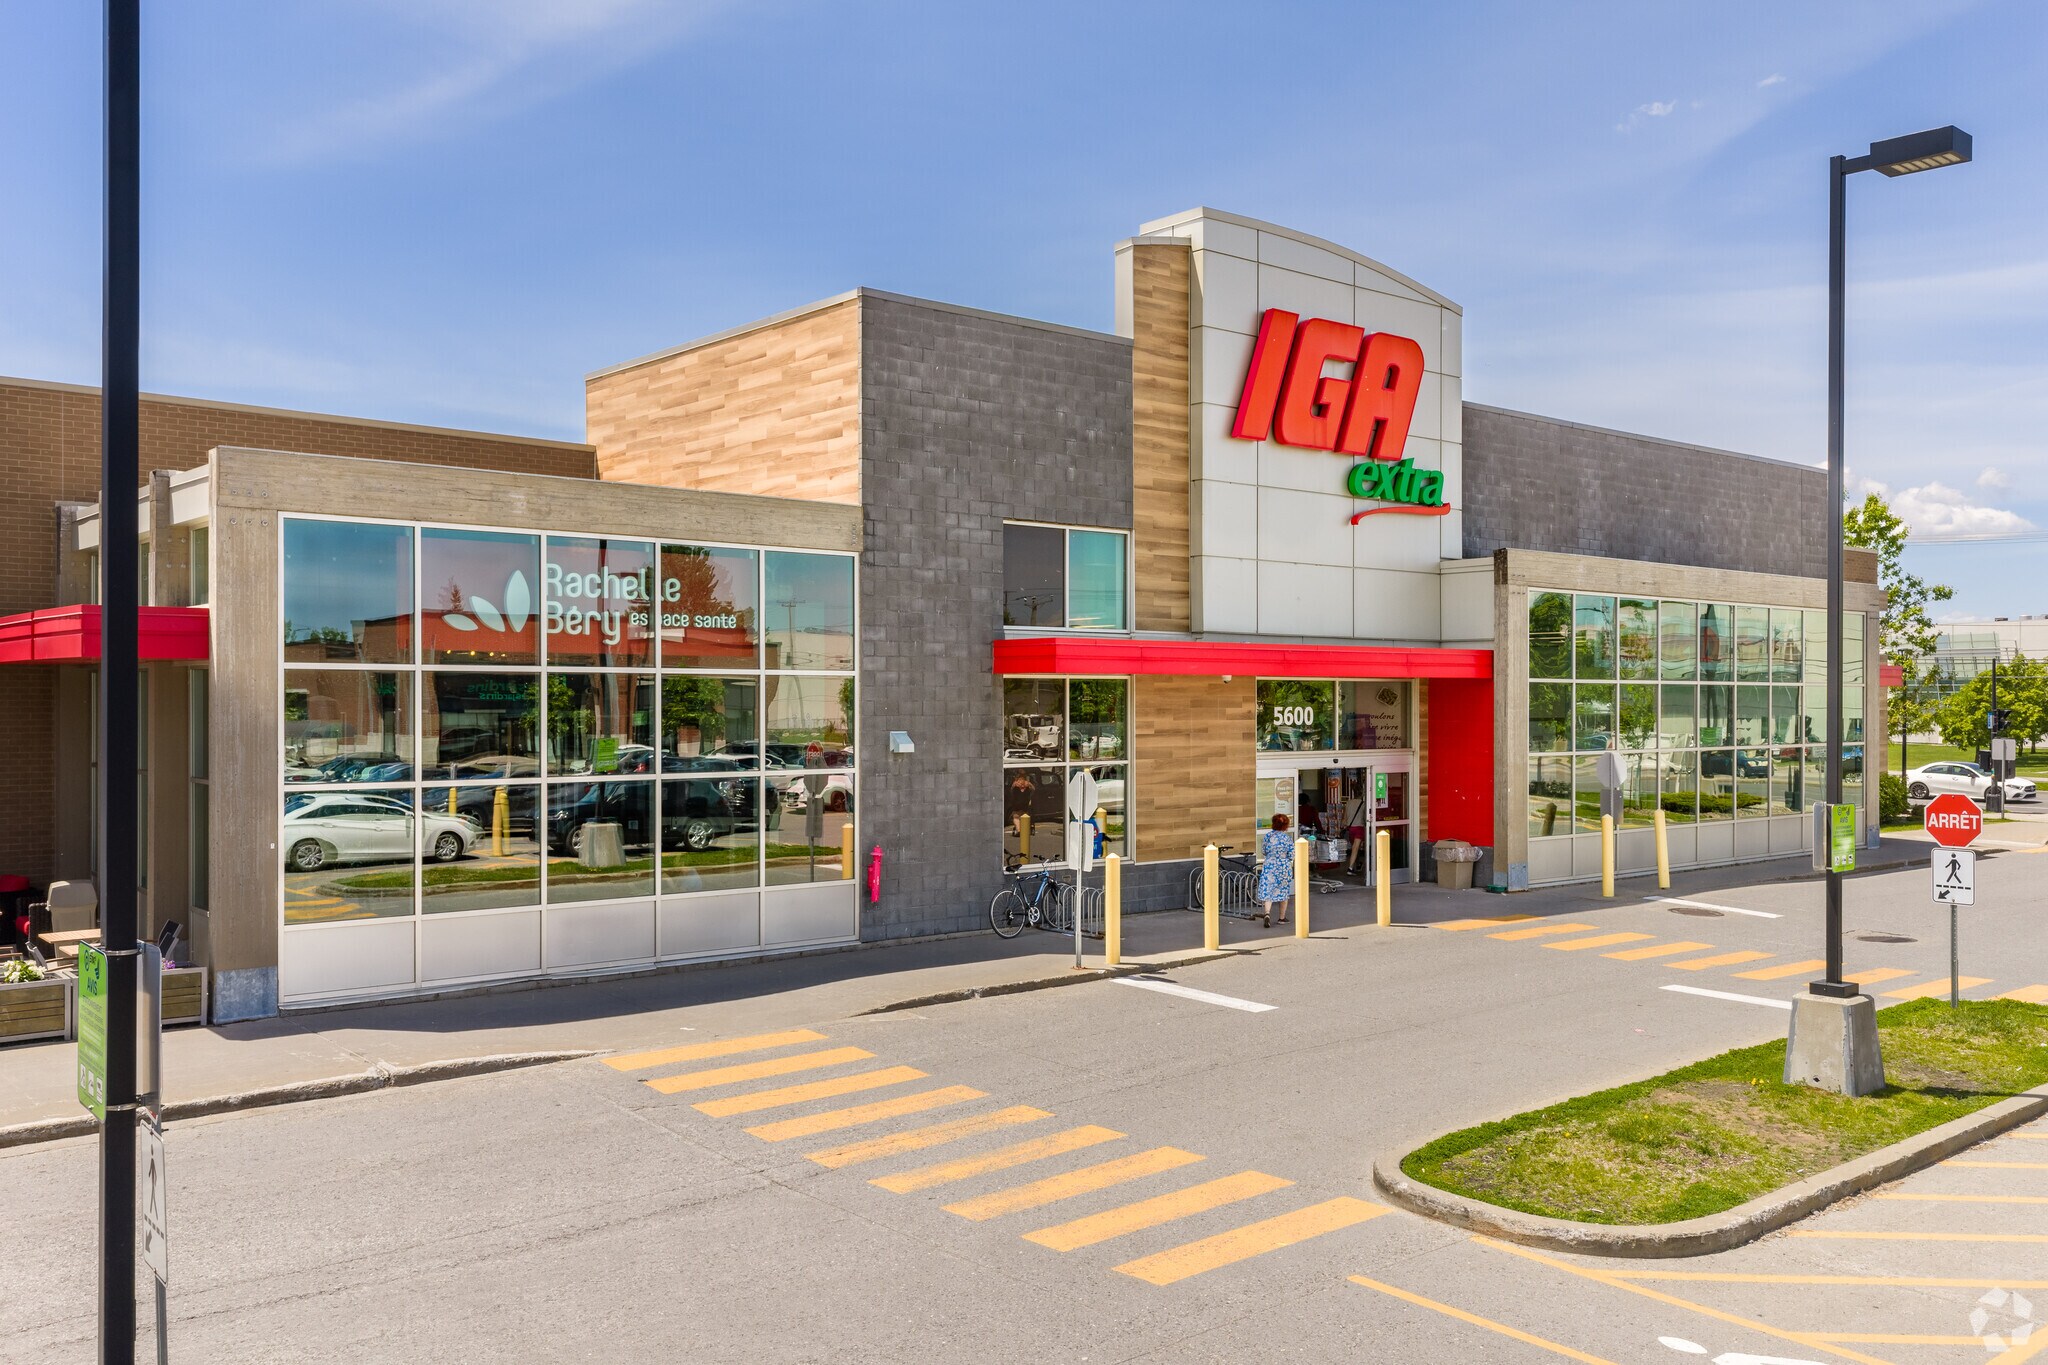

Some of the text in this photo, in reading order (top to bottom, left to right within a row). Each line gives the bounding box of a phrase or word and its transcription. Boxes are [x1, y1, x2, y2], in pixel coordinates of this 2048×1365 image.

[1232, 308, 1425, 461] IGA
[1347, 457, 1444, 507] extra
[546, 563, 681, 603] Rachele
[546, 601, 621, 646] Béry
[631, 612, 737, 629] esace santé
[1273, 706, 1314, 726] 5600
[1380, 723, 1399, 731] vivre
[1928, 811, 1980, 830] ARRÊT
[86, 976, 98, 996] AVIS
